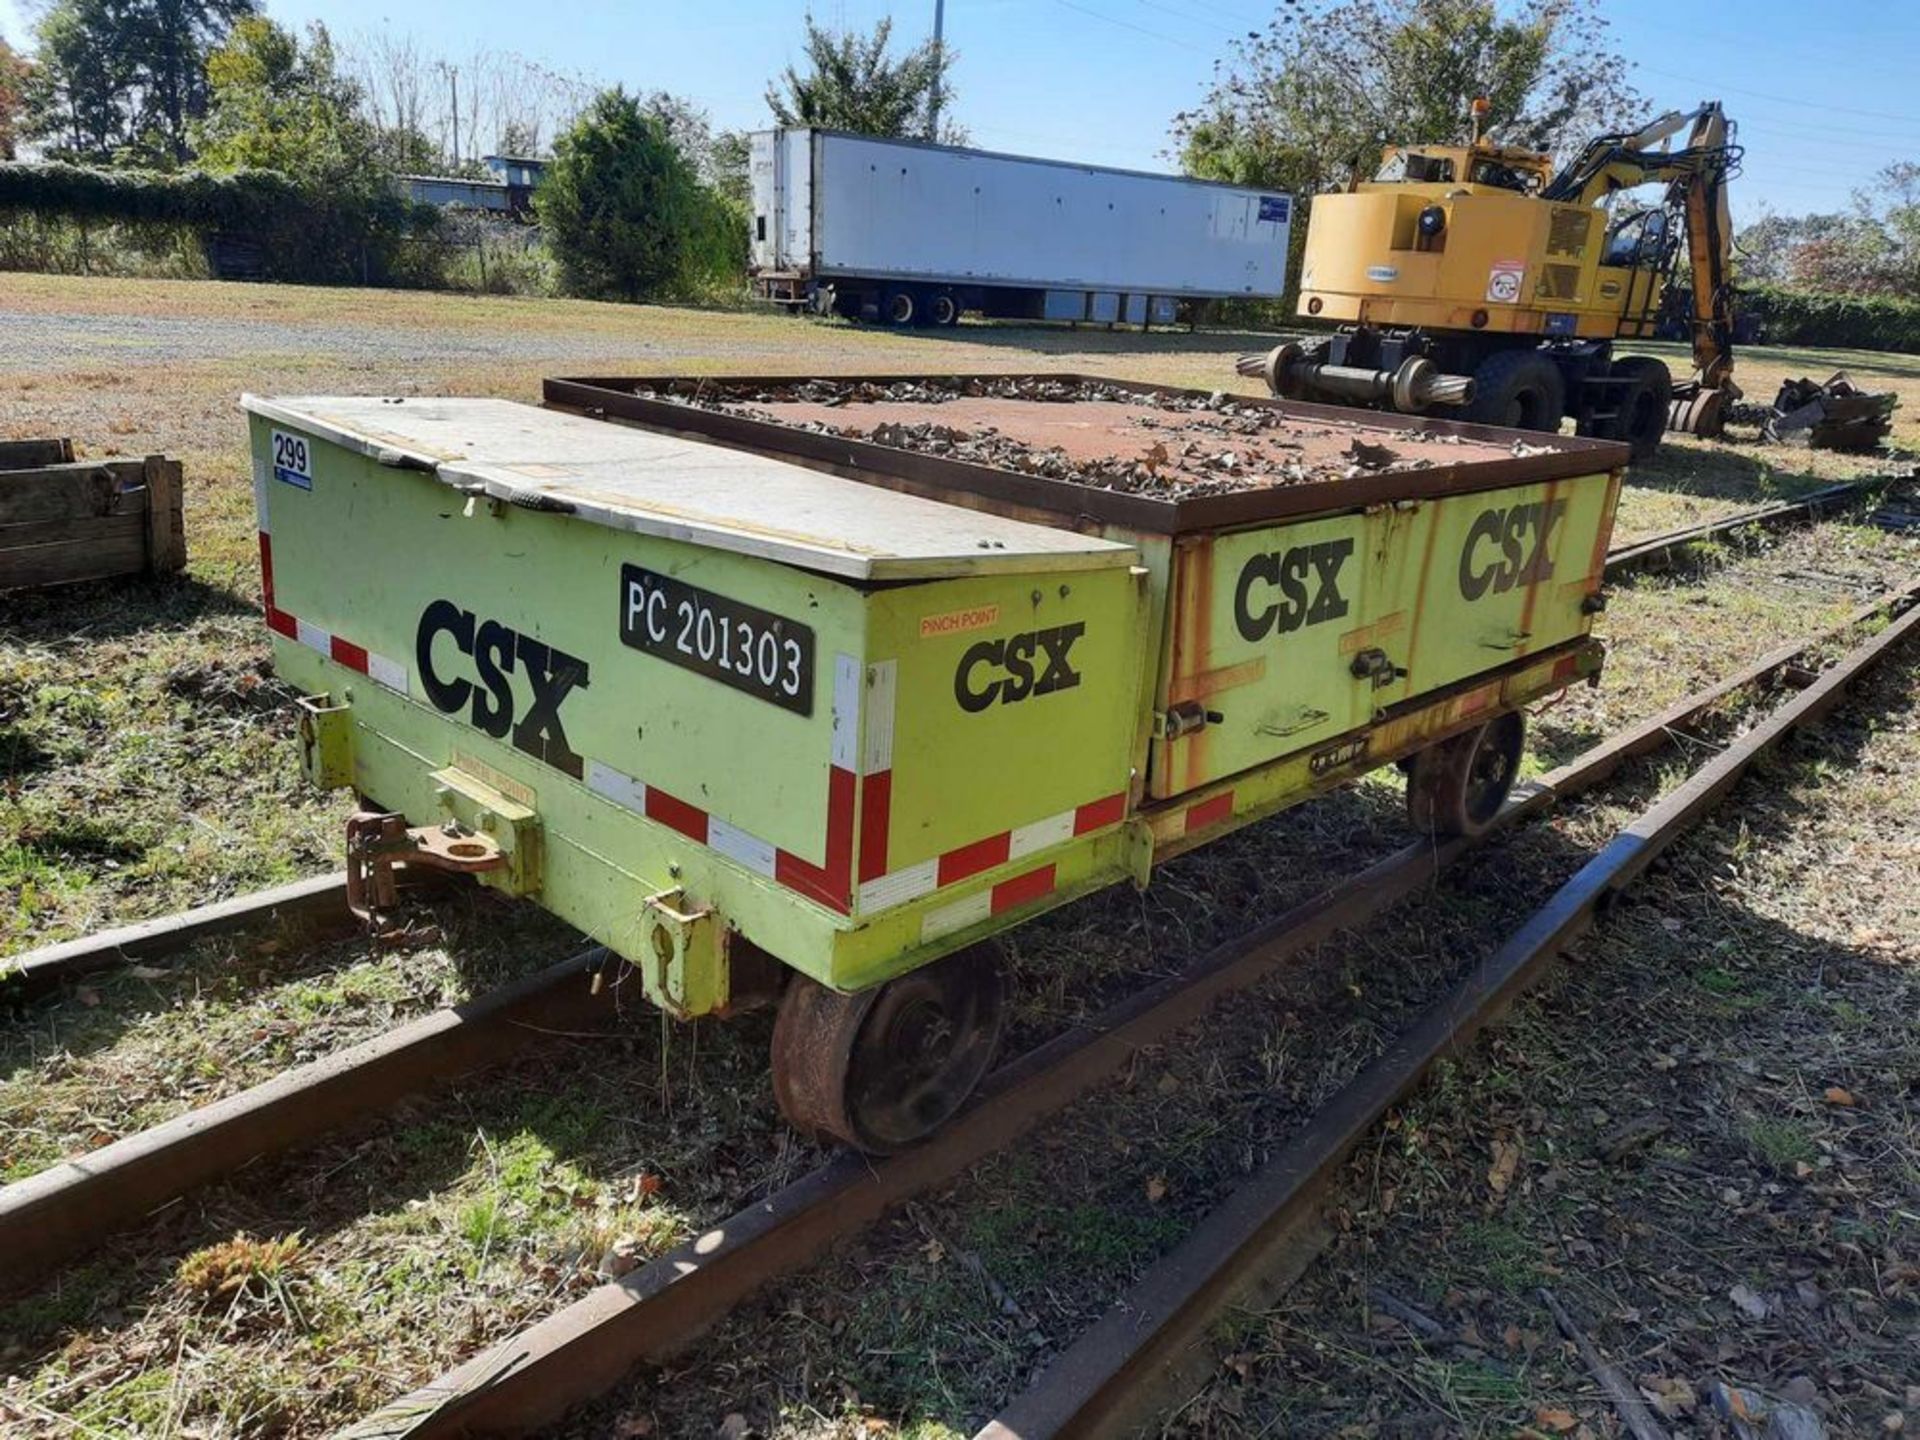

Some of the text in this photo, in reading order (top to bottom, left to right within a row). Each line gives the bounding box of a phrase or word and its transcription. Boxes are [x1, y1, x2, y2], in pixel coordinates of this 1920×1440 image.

[275, 433, 307, 473] 299
[1234, 537, 1355, 642] CSX
[1460, 498, 1568, 602] CSX
[628, 581, 802, 696] PC 201303
[921, 607, 998, 635] PINCH POINT
[954, 620, 1086, 713] CSX
[416, 599, 591, 782] CSX
